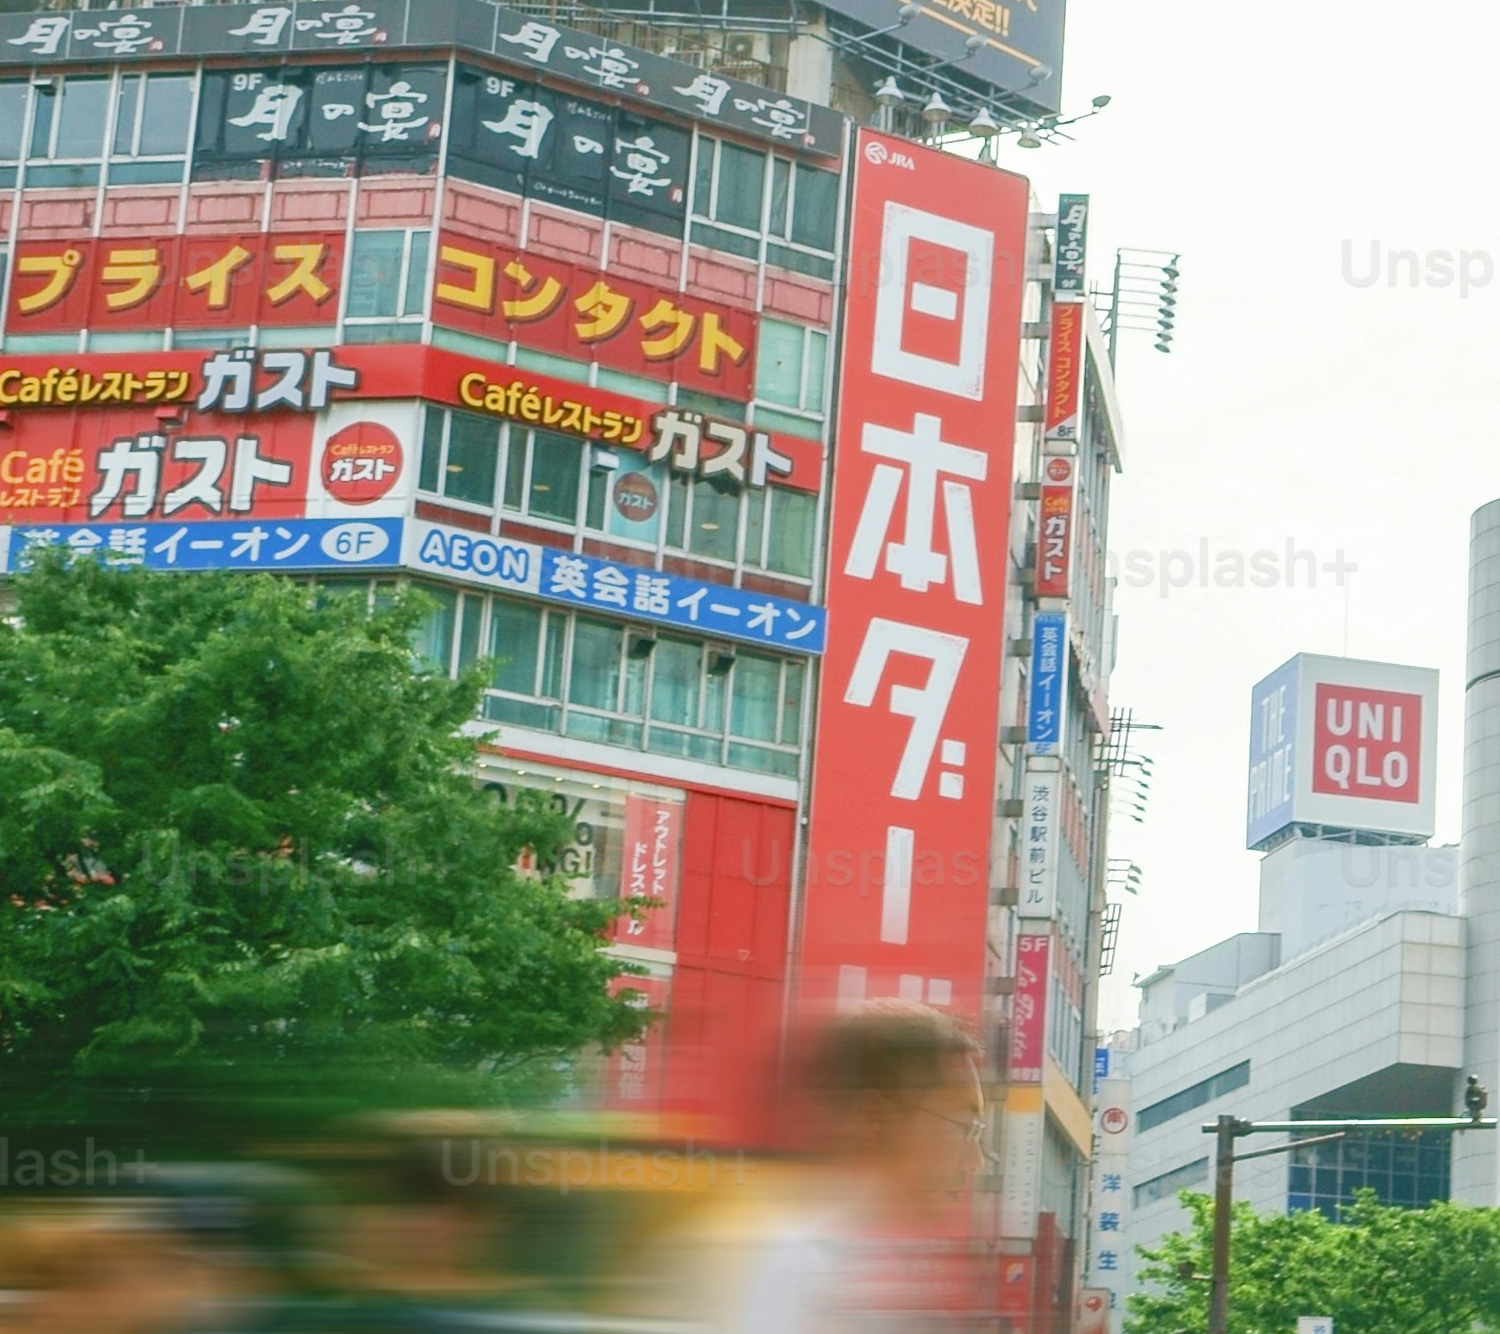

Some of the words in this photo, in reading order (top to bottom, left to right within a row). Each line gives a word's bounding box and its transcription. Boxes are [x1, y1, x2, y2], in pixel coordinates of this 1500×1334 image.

[7, 16, 153, 55] 月の宴
[228, 4, 376, 45] 月の宴
[232, 74, 263, 92] 9F
[499, 21, 633, 91] 月の宴
[229, 81, 431, 144] 月の宴
[486, 77, 514, 98] 9F
[672, 75, 808, 140] 月の宴
[481, 98, 673, 197] 月の宴
[888, 151, 915, 171] JRA
[17, 242, 336, 315] プライス
[436, 244, 747, 371] コンタクト
[198, 346, 359, 413] ガスト
[0, 448, 85, 487] Café
[89, 432, 292, 518] ガスト
[328, 456, 396, 483] ガスト
[648, 409, 793, 488] ガスト
[335, 531, 376, 556] 6F
[418, 528, 529, 583] AEON
[1045, 514, 1068, 582] ガスト
[549, 553, 818, 641] 英会話イーオン
[1326, 698, 1403, 744] UNI
[1323, 743, 1410, 790] QLO
[1026, 784, 1050, 904] 渋谷駅前ビル
[1019, 937, 1048, 953] 5F
